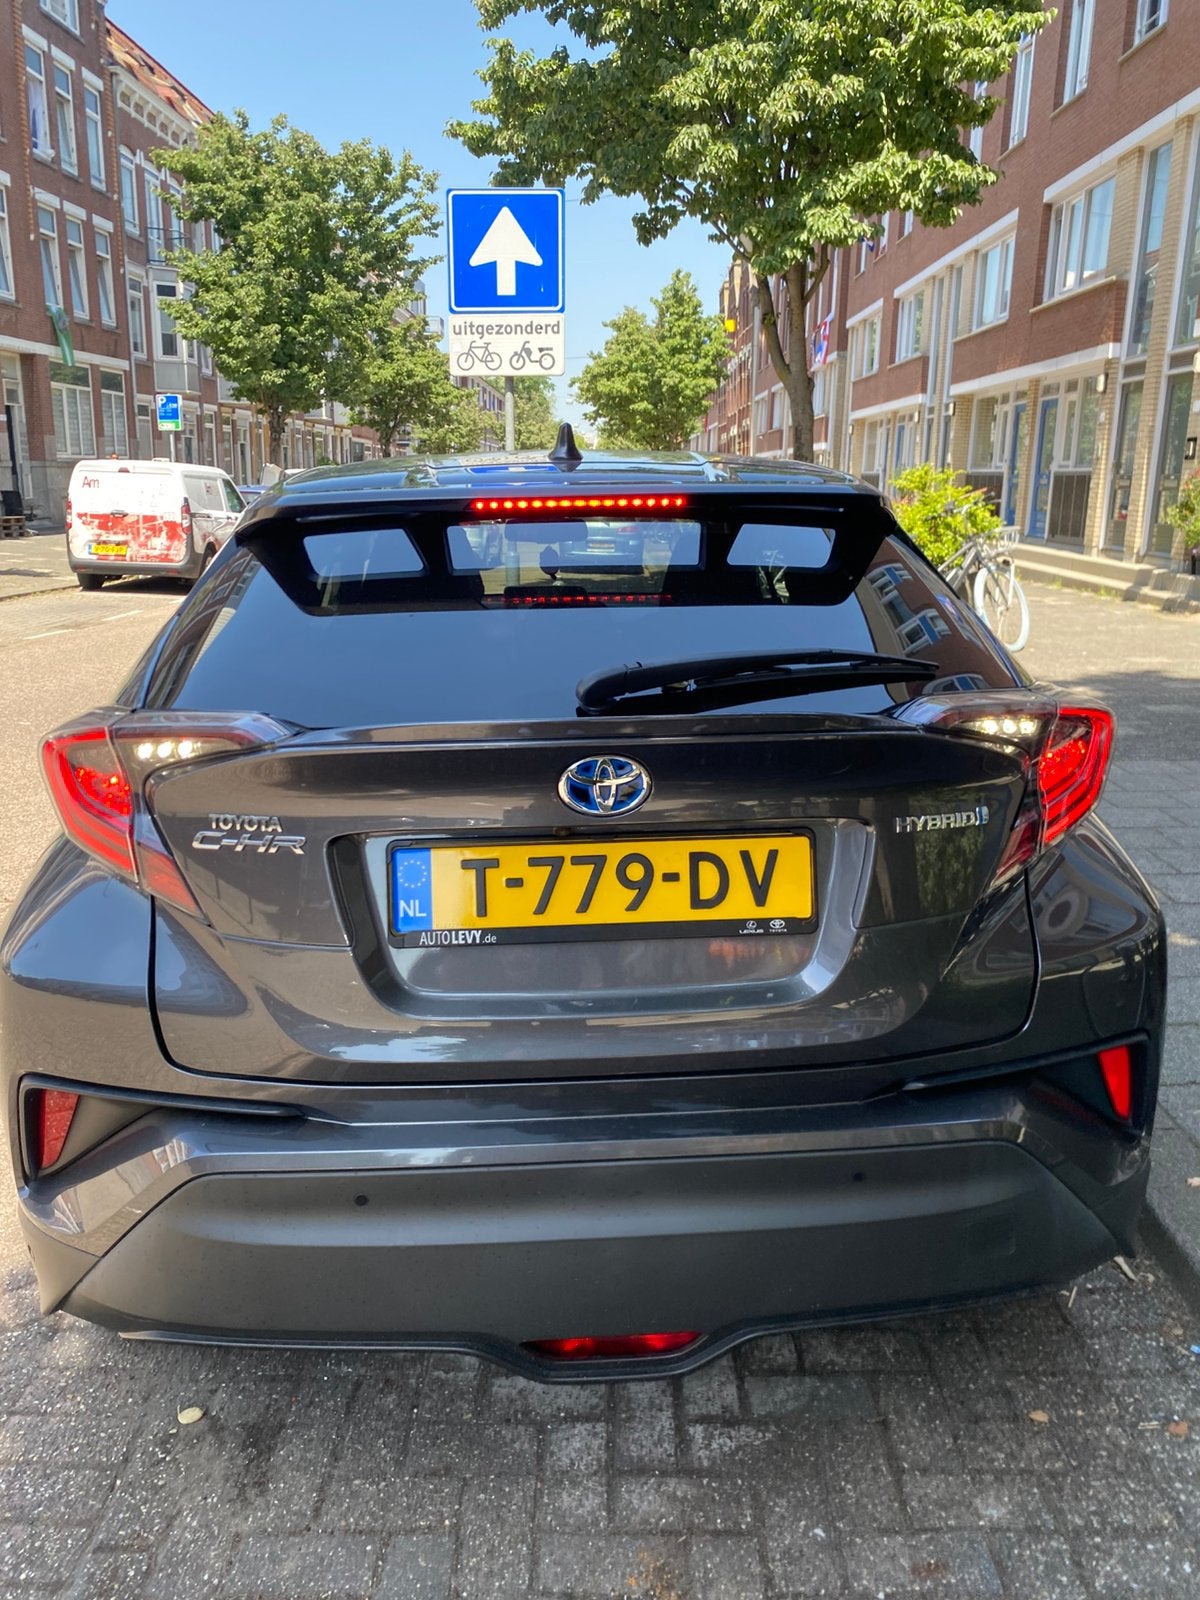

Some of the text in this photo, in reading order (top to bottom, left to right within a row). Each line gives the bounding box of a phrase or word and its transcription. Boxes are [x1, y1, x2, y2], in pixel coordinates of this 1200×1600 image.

[453, 321, 560, 339] uitgezonderd
[159, 397, 166, 408] P
[208, 813, 283, 833] TOYOTA
[896, 811, 976, 833] HYBRID
[192, 831, 306, 855] C-HR
[461, 849, 779, 918] T-779-DV
[399, 899, 427, 918] NL
